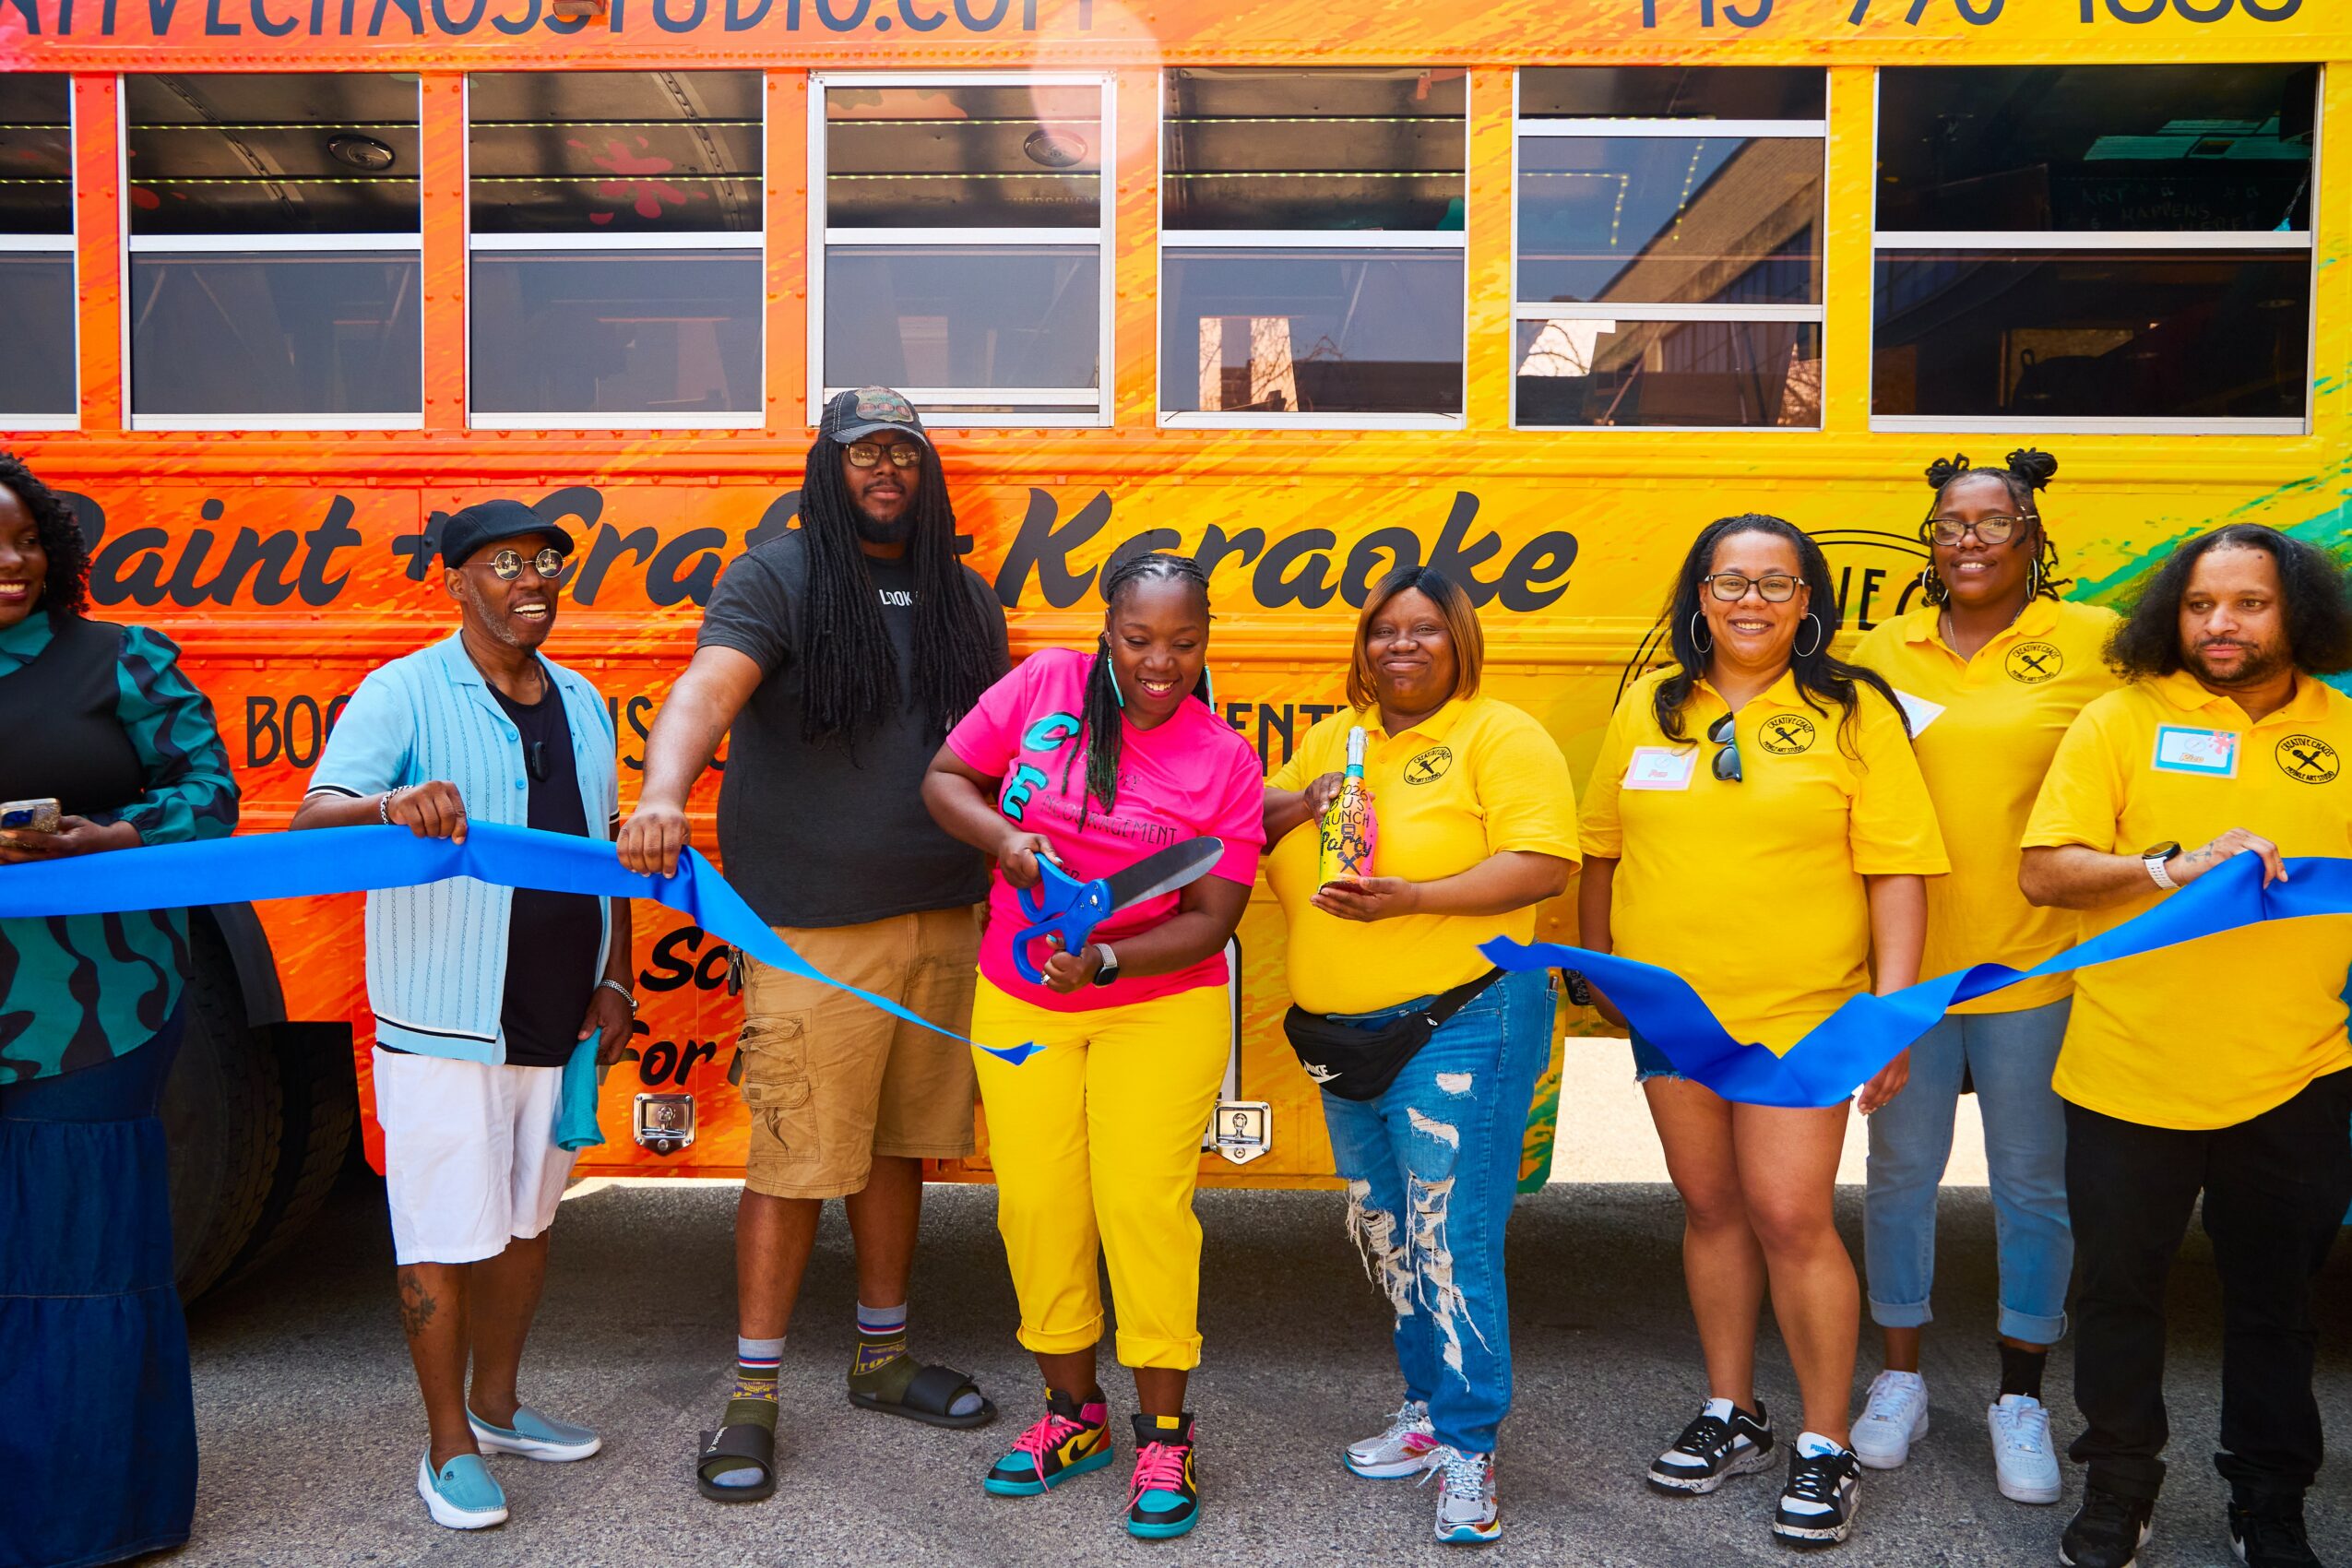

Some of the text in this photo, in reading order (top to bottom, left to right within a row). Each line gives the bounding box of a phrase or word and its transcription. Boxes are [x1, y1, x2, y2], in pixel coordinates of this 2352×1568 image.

[1767, 717, 1797, 730] CREATIVE
[2280, 737, 2334, 757] CREATIVE CHAOS
[1329, 796, 1364, 812] BUS
